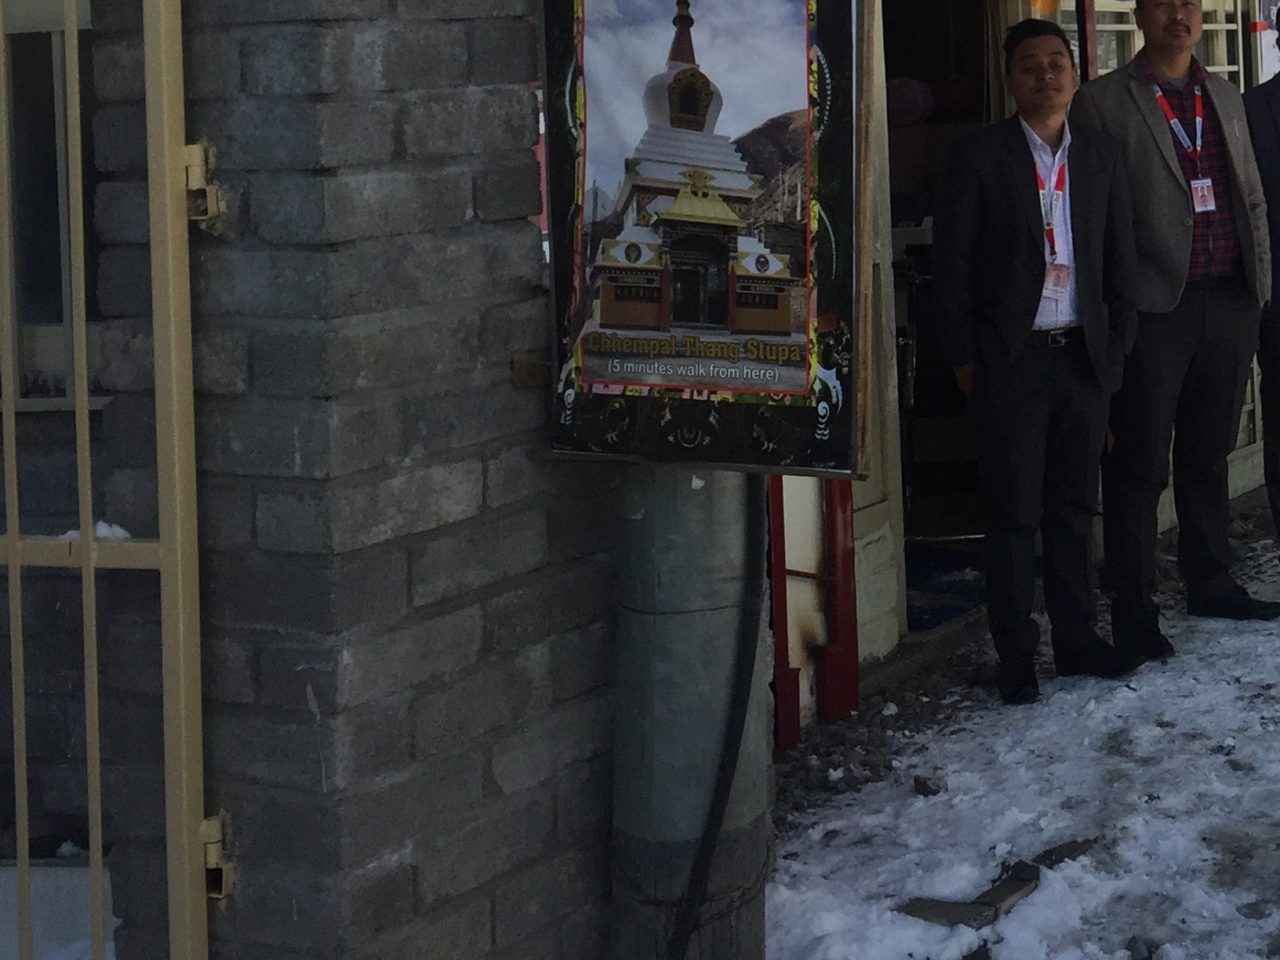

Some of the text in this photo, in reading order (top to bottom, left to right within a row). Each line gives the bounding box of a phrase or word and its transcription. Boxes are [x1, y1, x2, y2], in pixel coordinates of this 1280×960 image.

[588, 331, 800, 365] Chhempal Thang Stupa
[608, 359, 780, 382] (5 minutes walk from here)
